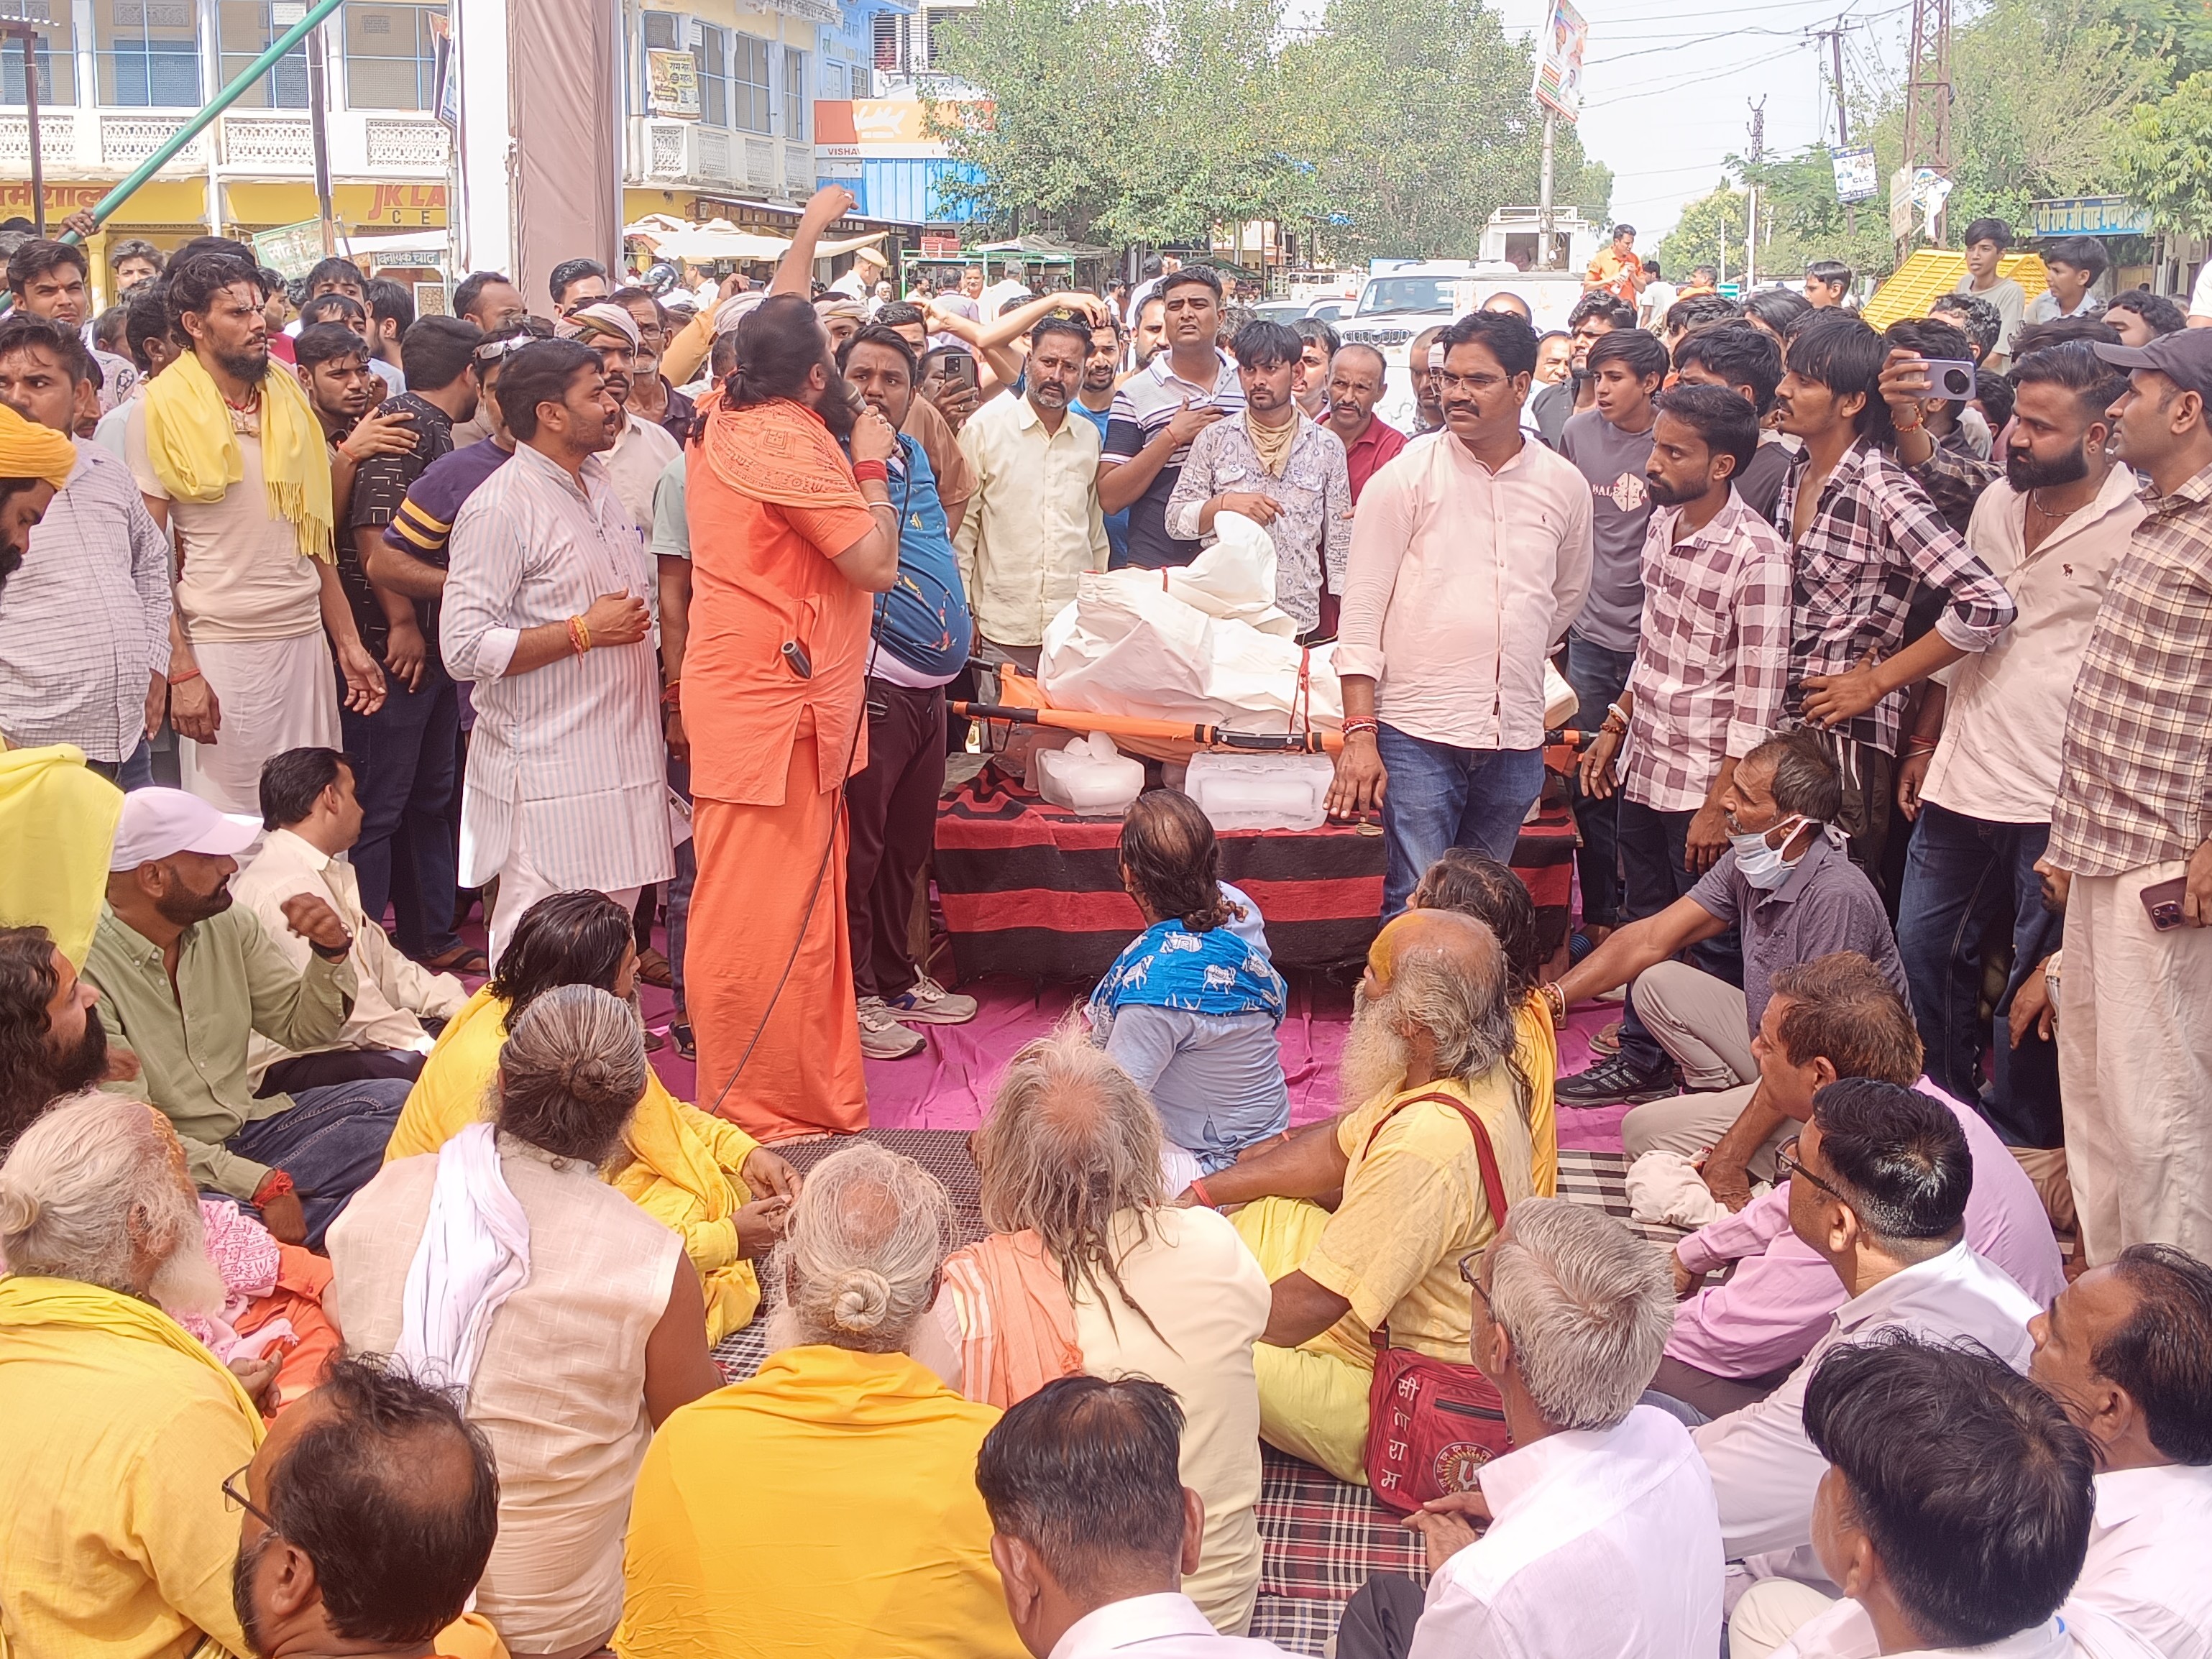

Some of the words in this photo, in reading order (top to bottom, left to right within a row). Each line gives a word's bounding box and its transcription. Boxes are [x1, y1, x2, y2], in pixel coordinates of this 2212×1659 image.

[1852, 175, 1871, 184] CLC
[367, 185, 404, 221] JK
[410, 185, 452, 207] LA
[2050, 209, 2068, 231] राम
[412, 252, 438, 264] चाट
